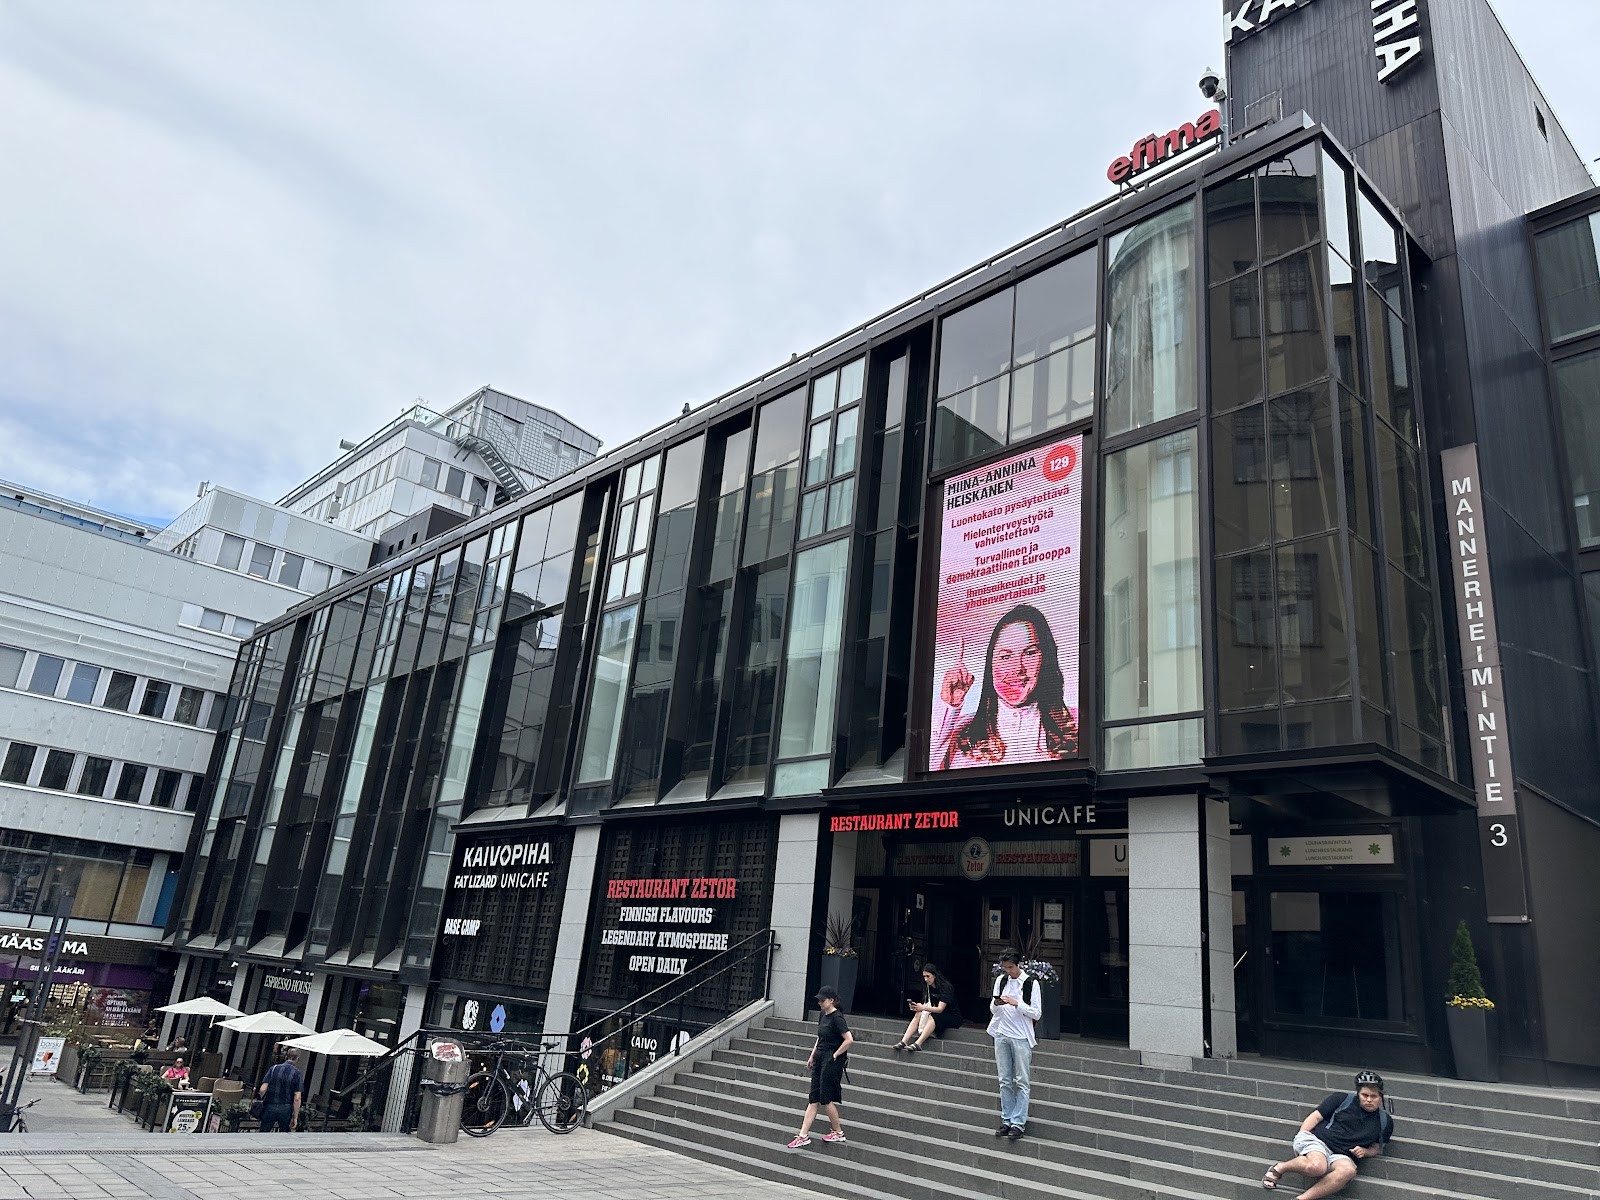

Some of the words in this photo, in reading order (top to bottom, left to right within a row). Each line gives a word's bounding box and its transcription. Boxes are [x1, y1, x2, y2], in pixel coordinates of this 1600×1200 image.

[1106, 109, 1222, 183] efima
[1049, 455, 1070, 472] 129
[947, 457, 1037, 496] MIINA-ANNIINA
[946, 479, 1014, 511] HEISKANEN
[951, 506, 1003, 529] Luontokato
[1004, 484, 1070, 515] pysäytettävä
[963, 507, 1054, 542] Mielenterveystyötä
[974, 523, 1040, 549] vahvistettava
[974, 546, 1028, 566] Turvallinen
[1029, 542, 1039, 555] ja
[946, 559, 1020, 585] demokraattinen
[1022, 546, 1071, 566] Eurooppa
[1035, 573, 1046, 585] ja
[1451, 477, 1503, 802] MANNERHEIMINTIE
[830, 813, 911, 832] RESTAURANT
[914, 810, 959, 829] ZETOR
[1004, 804, 1097, 826] UNICAFE
[1489, 823, 1508, 847] 3
[462, 842, 550, 868] KAIVOPIHA
[966, 860, 984, 872] Zetor
[995, 852, 1078, 865] RESTAURANT
[453, 875, 469, 889] FAT
[467, 874, 498, 889] LIZARD
[500, 871, 550, 889] UNICAFE
[606, 878, 690, 899] RESTAURANT
[690, 877, 737, 899] ZETOR
[619, 906, 660, 922] FINNISH
[659, 907, 713, 924] FLAVOURS
[443, 918, 462, 935] BASE
[460, 919, 481, 937] CAMP
[601, 930, 657, 947] LEGENDARY
[656, 931, 729, 951] ATMOSPHERE
[628, 955, 656, 973] OPEN
[655, 956, 688, 975] DAILY
[264, 974, 292, 991] ESPRESSO
